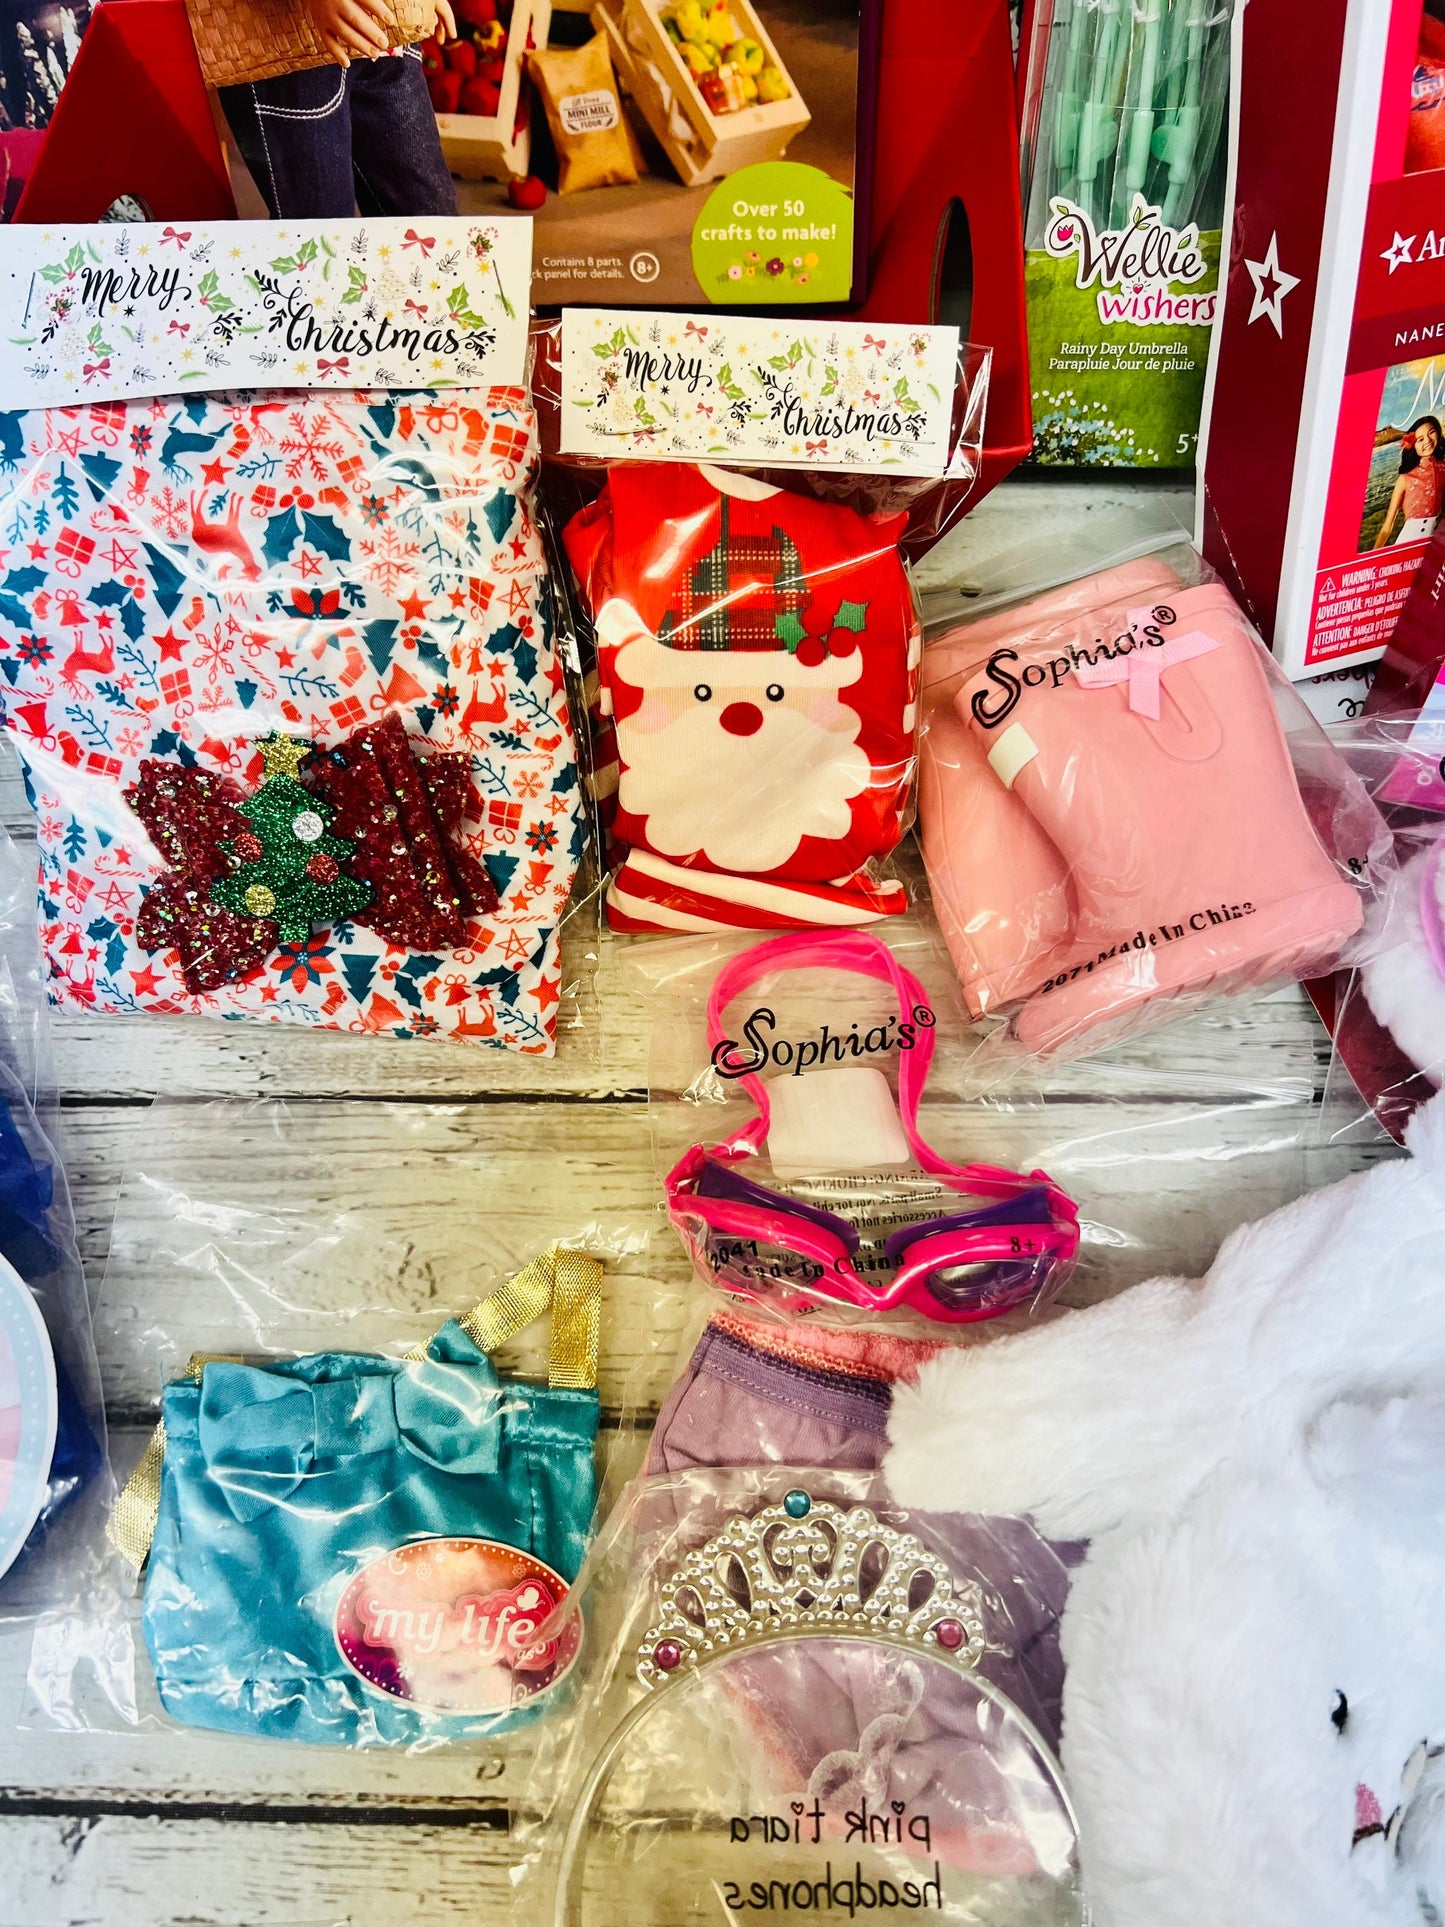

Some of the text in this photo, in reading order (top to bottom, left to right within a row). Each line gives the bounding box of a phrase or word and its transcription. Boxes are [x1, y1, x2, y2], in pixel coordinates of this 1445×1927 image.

[568, 105, 610, 119] MINI MILL
[580, 119, 602, 128] FLOUR
[732, 199, 805, 217] Over 50
[700, 223, 837, 241] crafts to make!
[1049, 212, 1202, 283] Wellie
[542, 256, 624, 268] Contains 8 parts.
[636, 261, 653, 275] 8+
[544, 269, 571, 281] panel
[573, 268, 588, 279] for
[590, 268, 625, 279] details.
[81, 262, 192, 318] Merry
[1101, 288, 1217, 321] wishers
[285, 289, 461, 361] Christmas
[1060, 342, 1188, 357] Rainy Day Umbrella
[623, 347, 713, 393] Merry
[1049, 358, 1195, 373] Parapluie Jour de pluie
[782, 386, 903, 441] Christmas
[1341, 566, 1377, 588] WARNING:
[1378, 562, 1403, 577] CHOKING
[1316, 596, 1364, 621] ADVERTENCIA:
[1041, 961, 1095, 994] 2071
[1096, 930, 1158, 965] Made
[1158, 922, 1185, 942] In
[1009, 1235, 1036, 1253] 8+
[710, 1240, 758, 1273] 2041
[833, 1253, 905, 1275] China
[368, 1600, 536, 1658] my life
